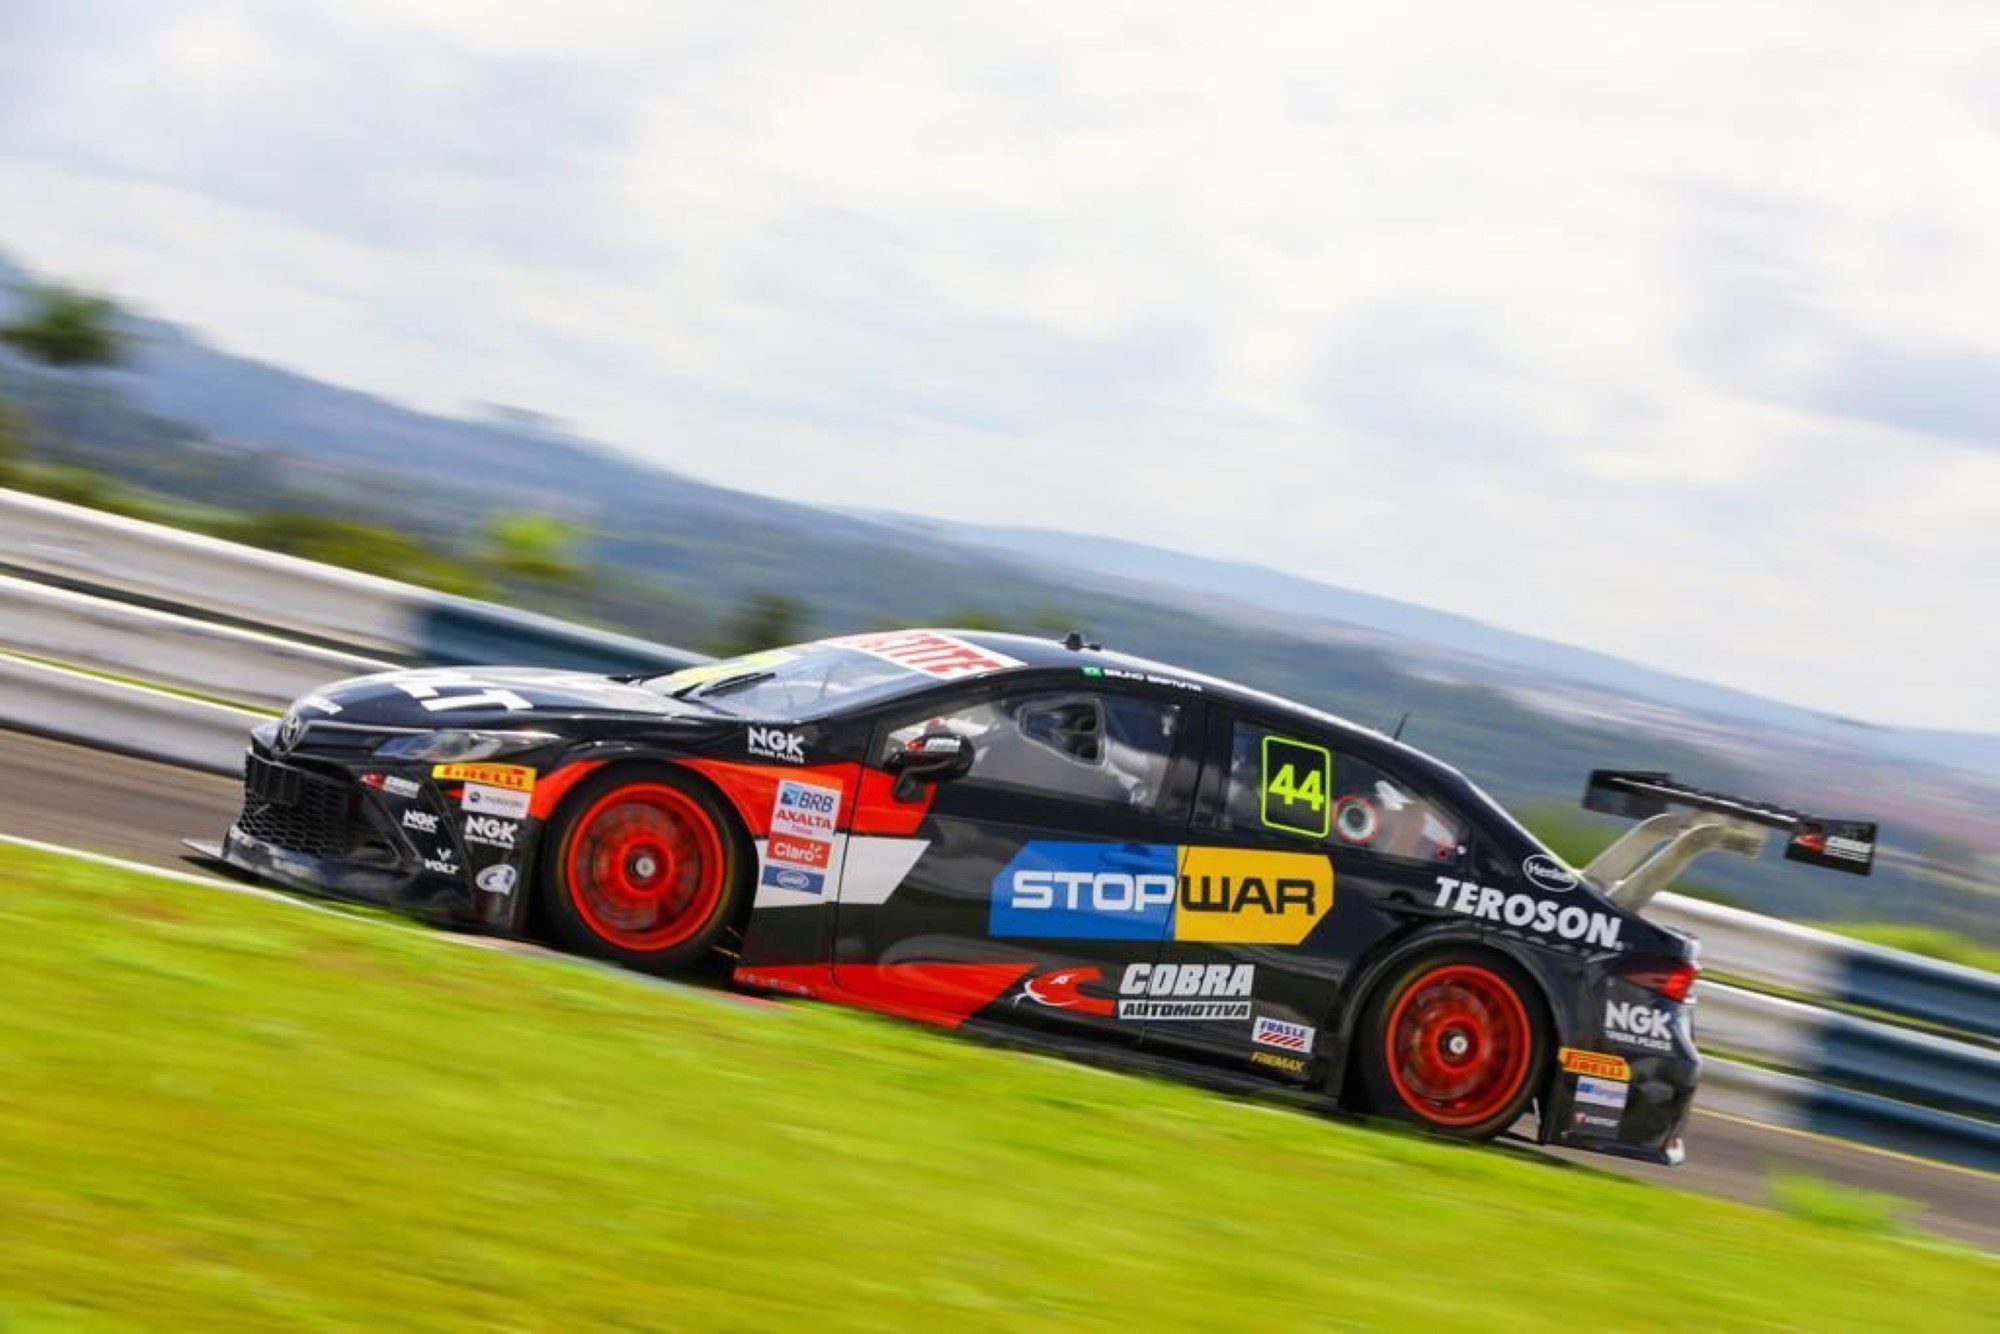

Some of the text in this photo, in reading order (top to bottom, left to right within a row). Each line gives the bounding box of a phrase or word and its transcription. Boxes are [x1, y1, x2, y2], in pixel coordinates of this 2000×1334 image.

[749, 726, 805, 757] NGK
[799, 791, 834, 814] BRB
[1268, 764, 1325, 811] 44
[465, 815, 519, 843] NGK
[775, 809, 832, 830] AXALTA
[775, 841, 816, 863] Claro
[1012, 870, 1316, 917] STOP WAR
[1434, 876, 1622, 949] TEROSON
[1119, 963, 1255, 997] COBRA
[1121, 1002, 1249, 1017] AUTOMOTIVA
[1605, 1000, 1672, 1041] NGK
